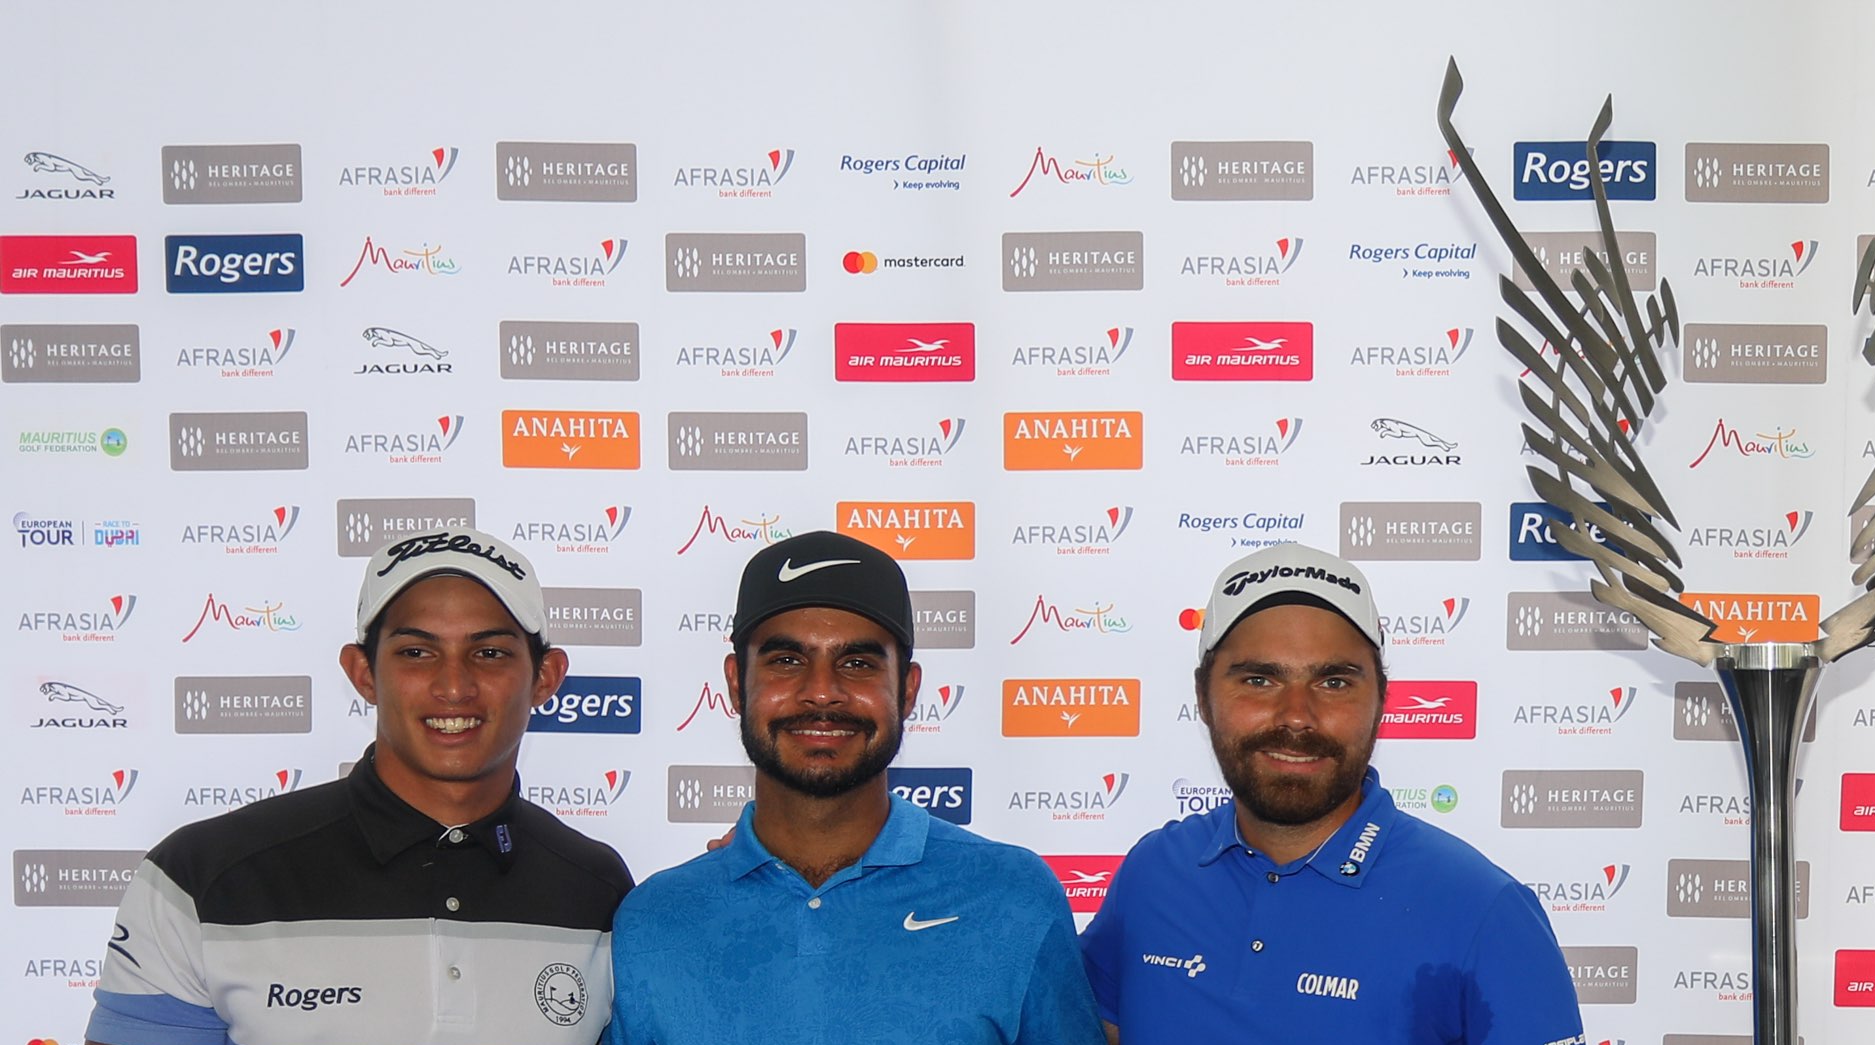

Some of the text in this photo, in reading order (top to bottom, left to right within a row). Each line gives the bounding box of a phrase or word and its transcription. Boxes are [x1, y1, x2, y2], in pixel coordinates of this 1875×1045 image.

[209, 164, 293, 177] HERITAGE
[841, 155, 965, 174] Rogers Capital
[1010, 147, 1126, 197] Mauritius
[1219, 162, 1304, 174] HERITAGE
[1523, 153, 1647, 189] Rogers
[339, 167, 435, 185] AFRASIA
[903, 180, 959, 190] Keep evolving
[17, 190, 114, 199] JAGUAR
[404, 186, 437, 197] different
[739, 189, 771, 197] different
[885, 256, 963, 267] mastercard
[1050, 252, 1134, 264] HERITAGE
[1350, 243, 1476, 262] Rogers Capital
[175, 246, 295, 282] Rogers
[340, 237, 455, 287] Mauritius
[1694, 259, 1793, 277] AFRASIA
[1413, 269, 1469, 279] Keep evolving
[1739, 280, 1760, 288] bank
[47, 344, 131, 356] HERITAGE
[177, 348, 274, 366] AFRASIA
[677, 348, 773, 365] AFRASIA
[1732, 345, 1818, 357] HERITAGE
[355, 364, 451, 373] JAGUAR
[513, 417, 628, 438] ANAHITA
[1013, 418, 1133, 441] ANAHITA
[19, 444, 98, 454] GOLF FEDERATION
[1690, 419, 1808, 468] Mauritius
[1361, 456, 1460, 465] JAGUAR
[848, 509, 964, 530] ANAHITA
[1179, 513, 1304, 532] Rogers Capital
[17, 529, 74, 548] TOUR
[95, 529, 139, 547] DUBAI
[513, 523, 608, 541] AFRASIA
[678, 506, 795, 555] Mauritius
[377, 532, 526, 581] Titleist
[1223, 565, 1361, 596] TaylorMade
[550, 608, 633, 620] HERITAGE
[1011, 686, 1129, 707] ANAHITA
[531, 693, 633, 723] ogers
[1514, 706, 1611, 723] AFRASIA
[21, 785, 118, 804] AFRASIA
[1009, 792, 1104, 809] AFRASIA
[1549, 790, 1634, 802] HERITAGE
[1349, 822, 1380, 863] BMW
[1143, 954, 1182, 968] VINCI
[1297, 973, 1359, 1000] COLMAR
[268, 984, 362, 1010] Rogers
